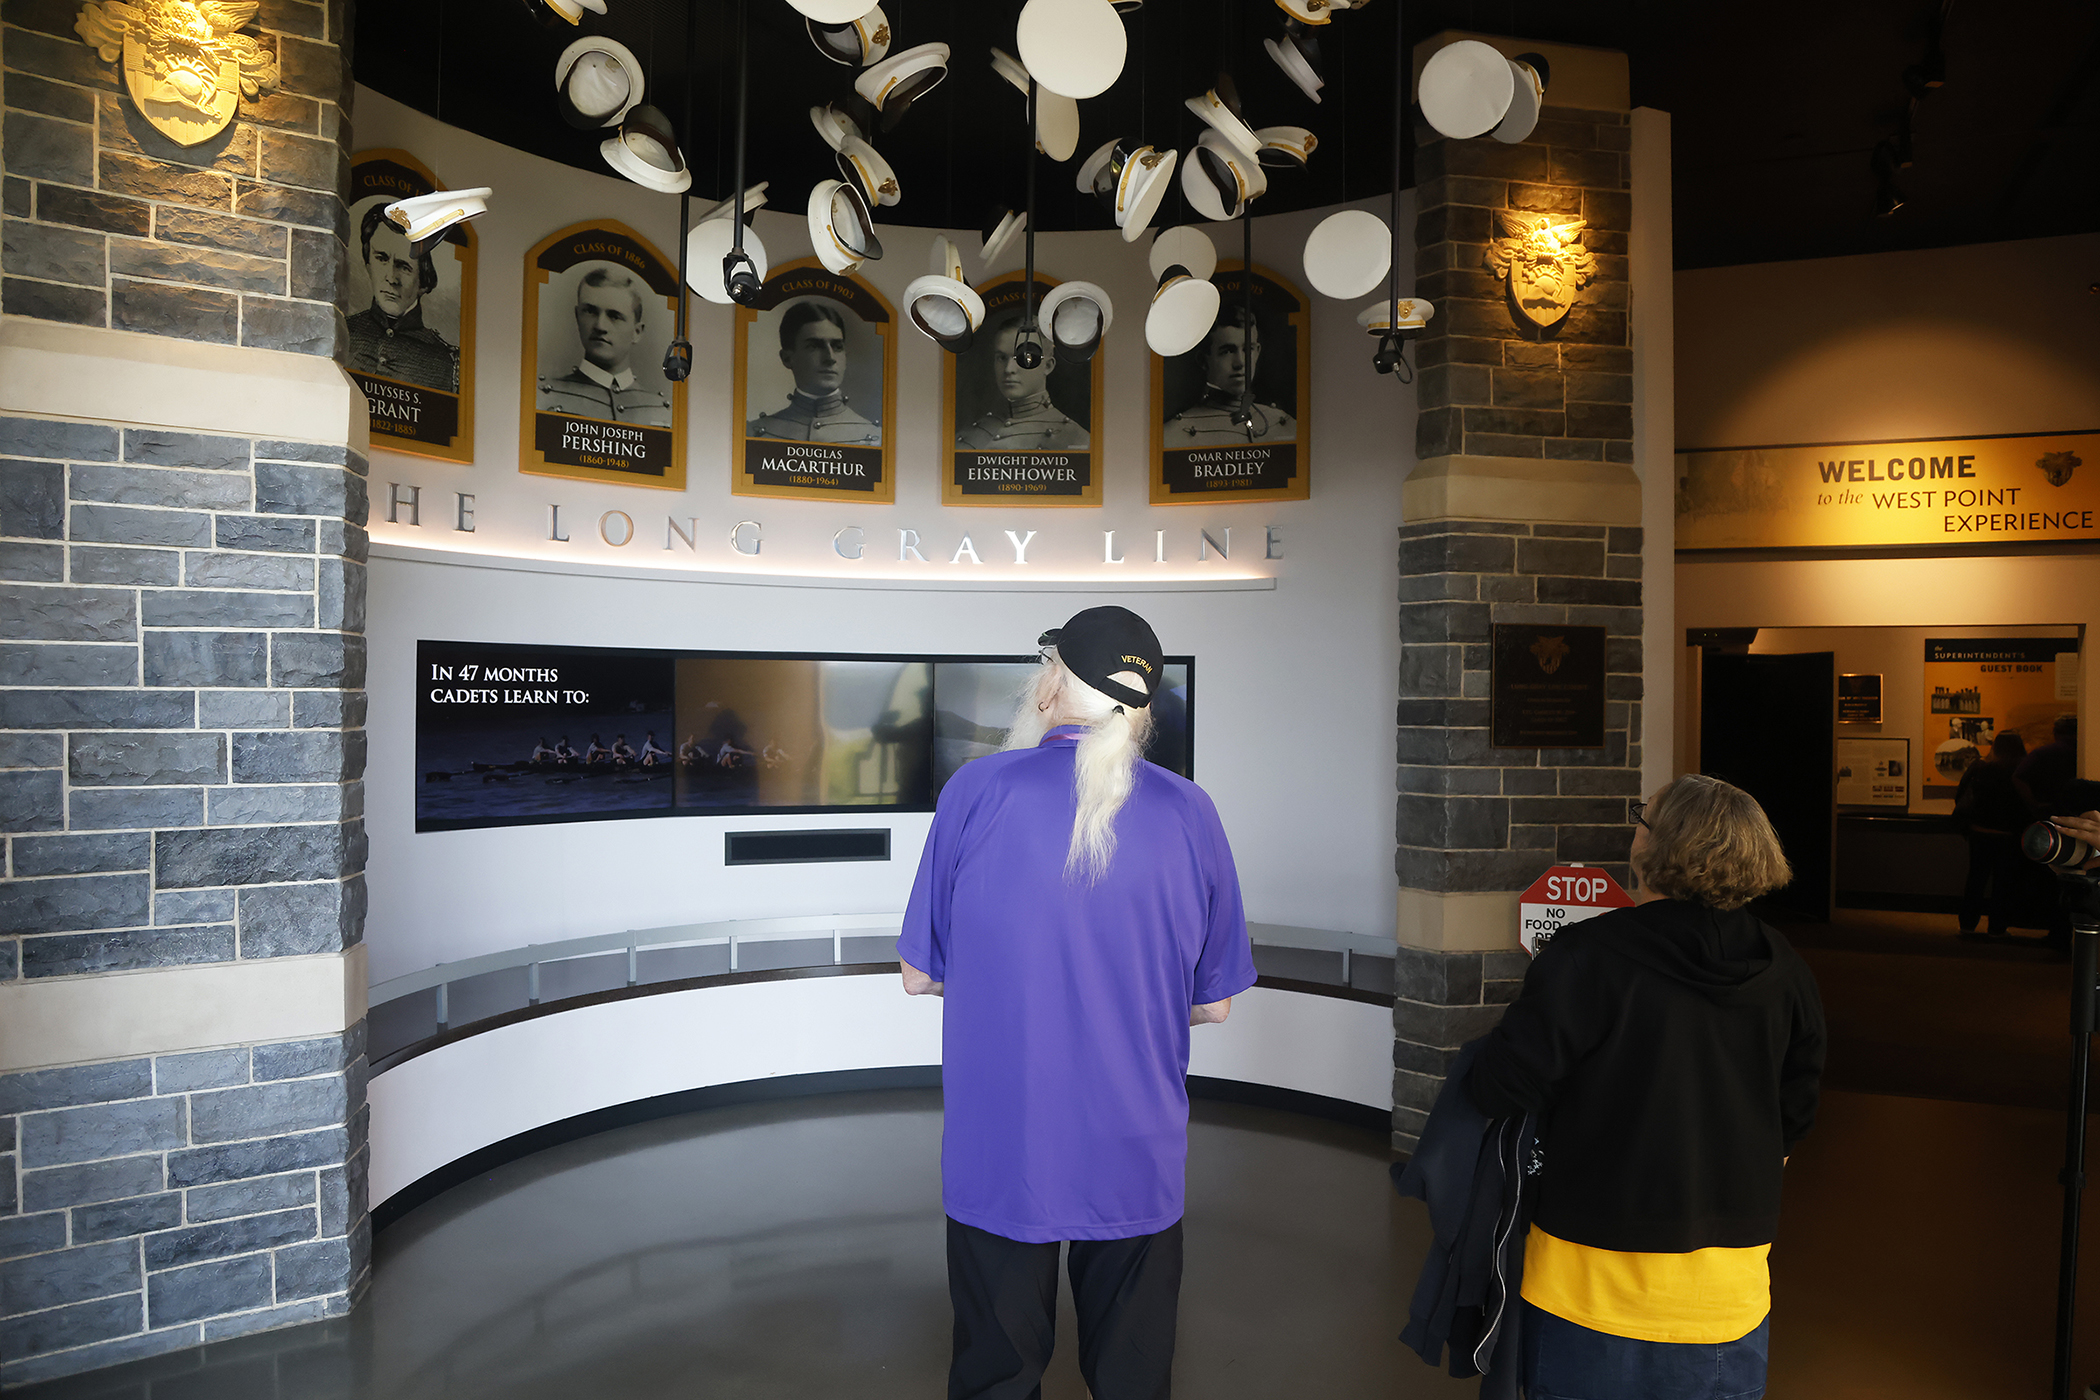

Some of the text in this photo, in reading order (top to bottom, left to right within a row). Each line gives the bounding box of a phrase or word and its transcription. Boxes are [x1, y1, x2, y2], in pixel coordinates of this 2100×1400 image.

[363, 175, 396, 187] CLASS
[398, 179, 413, 193] OF
[573, 242, 646, 269] CLASS OF 1886
[781, 279, 855, 300] CLASS OF 1903
[988, 291, 1020, 308] CLASS
[364, 381, 422, 405] ULYSSES S.
[368, 397, 421, 423] GRANT
[565, 421, 643, 442] JOHN JOSEPH
[562, 434, 646, 459] PERSHING
[787, 446, 843, 460] DOUGLAS
[1188, 448, 1271, 463] OMAR NELSON
[579, 454, 630, 469] (1860-1948)
[761, 457, 866, 477] MACARTHUR
[977, 455, 1069, 466] DWIGHT DAVID
[1194, 461, 1265, 478] BRADLEY
[1818, 455, 1976, 484] WELCOME
[789, 475, 839, 486] (1880-1964)
[968, 467, 1077, 481] EISENHOWER
[998, 483, 1047, 492] (1890-1969)
[1817, 487, 2021, 510] to the WEST POINT
[384, 481, 1285, 565] HE LONG GRAY LINE
[1944, 510, 2094, 533] EXPERIENCE
[1121, 654, 1153, 674] VETERAN
[1934, 652, 2026, 660] SUPERINTENDENT'S
[458, 664, 479, 682] 47
[483, 667, 559, 683] MONTHS
[1980, 664, 2044, 673] GUEST BOOK
[430, 688, 590, 704] CADETS LEARN TO:
[1546, 875, 1608, 903] STOP
[1546, 907, 1566, 919] NO
[1525, 919, 1562, 930] FOOD
